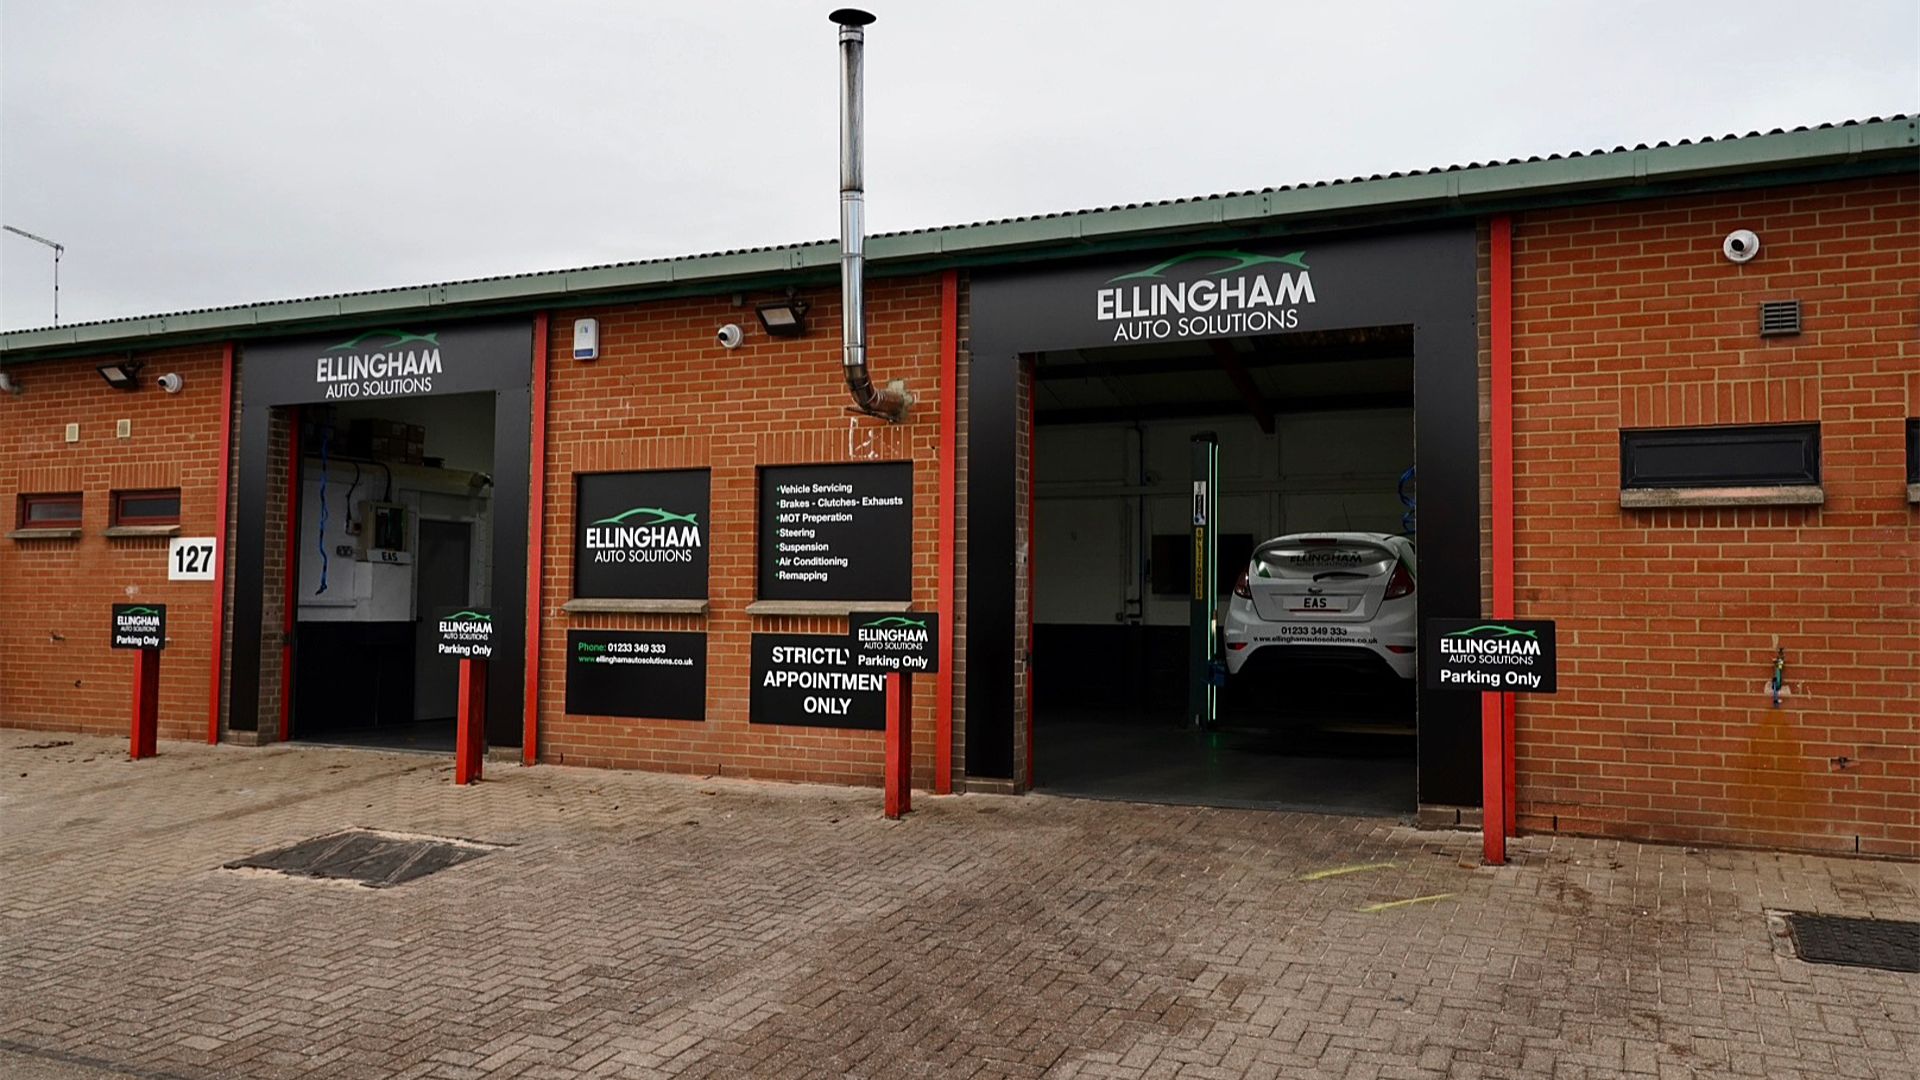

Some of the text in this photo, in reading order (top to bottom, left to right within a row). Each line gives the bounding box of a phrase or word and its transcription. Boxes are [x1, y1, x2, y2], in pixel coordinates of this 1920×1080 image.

[1097, 271, 1316, 320] ELLINGHAM
[1113, 308, 1298, 341] AUTO SOLUTIONS
[316, 348, 442, 383] ELLINGHAM
[325, 376, 432, 399] AUTO SOLUTIONS
[780, 483, 853, 494] Vehicle Servicing
[780, 499, 810, 509] Brakes
[862, 496, 903, 506] Exhausts
[780, 512, 853, 523] MOT Preperation
[586, 526, 701, 549] ELLINGHAM
[779, 528, 815, 538] Steering
[779, 542, 829, 553] Suspension
[175, 545, 214, 573] 127
[381, 551, 398, 561] EAS
[594, 549, 692, 563] AUTO SOLUTIONS
[779, 556, 848, 567] Air Conditioning
[1290, 553, 1363, 563] ELLINGHAM
[779, 571, 828, 581] Remapping
[1303, 598, 1327, 609] EAS
[117, 615, 160, 626] ELLINGHAM
[439, 621, 493, 634] ELLINGHAM
[1281, 626, 1309, 635] 01233
[1310, 626, 1328, 636] 349
[116, 635, 160, 647] Parking Only
[858, 628, 928, 643] ELLINGHAM
[438, 643, 492, 658] Parking Only
[578, 642, 666, 653] Phone: 01233 349 333
[864, 642, 923, 651] AUTO SOLUTIONS
[1440, 638, 1541, 656] ELLINGHAM
[858, 654, 928, 670] Parking Only
[1448, 654, 1534, 666] AUTO SOLUTIONS
[763, 671, 887, 692] APPOINTMEN
[1440, 669, 1541, 688] Parking Only
[803, 696, 852, 715] ONLY
